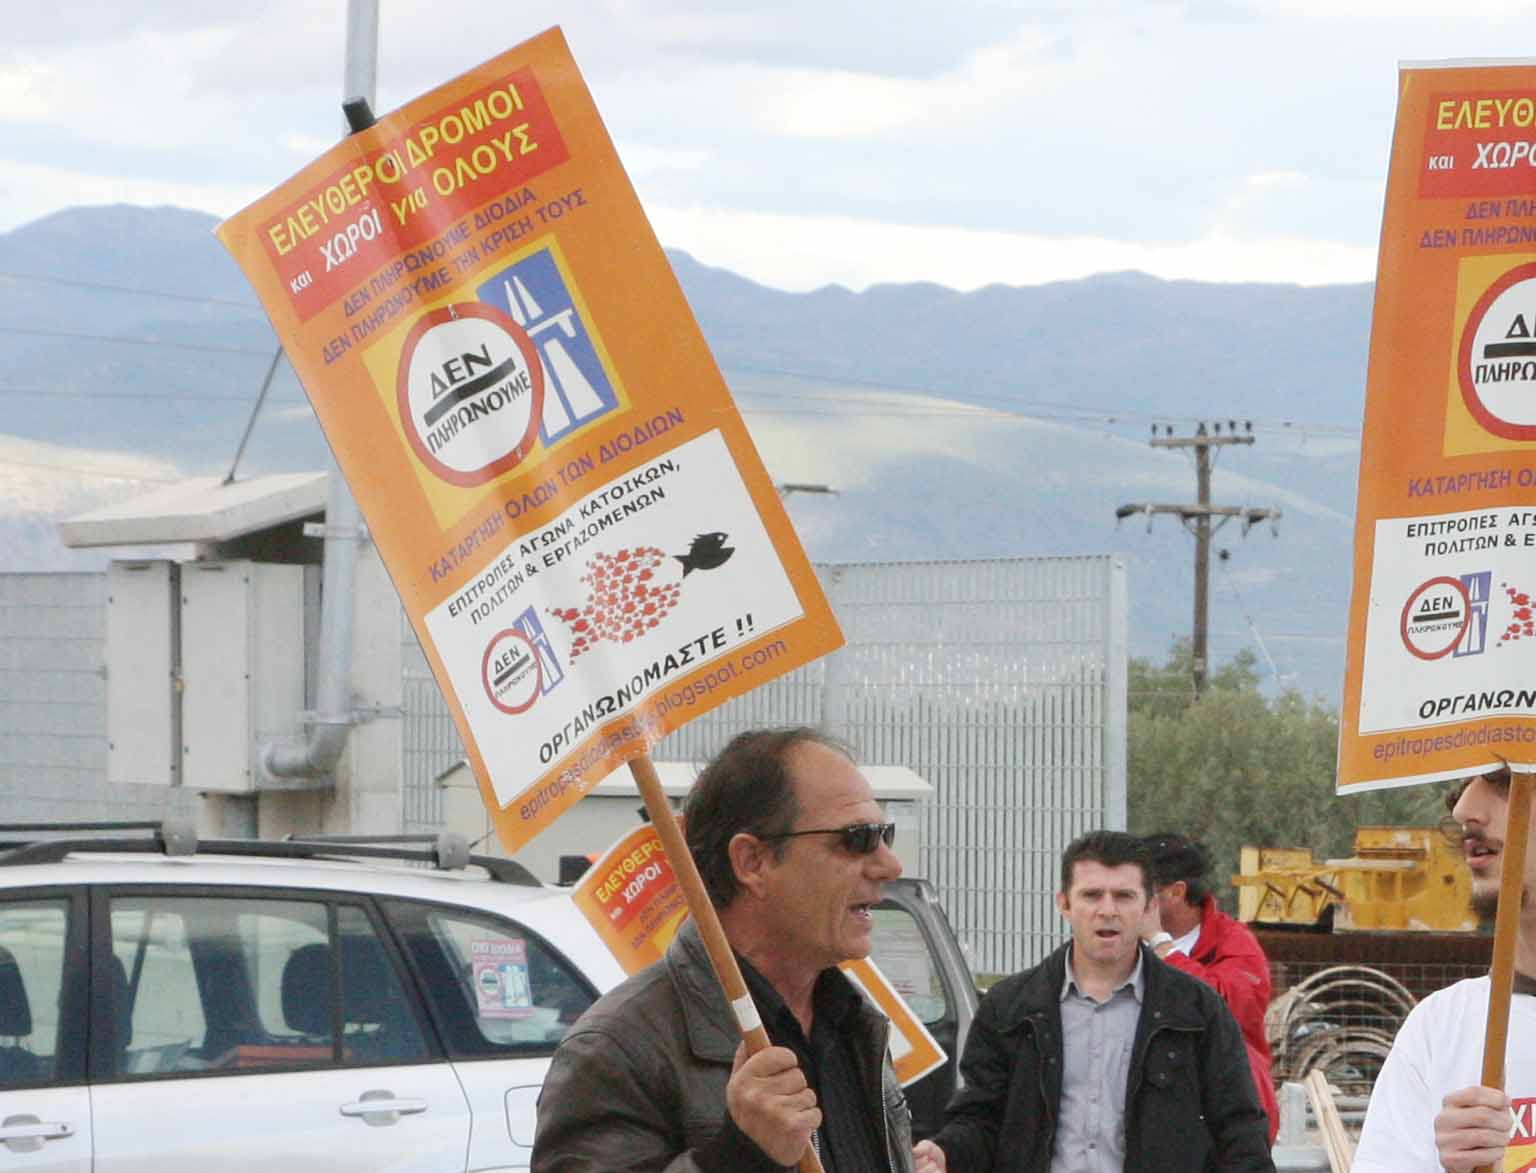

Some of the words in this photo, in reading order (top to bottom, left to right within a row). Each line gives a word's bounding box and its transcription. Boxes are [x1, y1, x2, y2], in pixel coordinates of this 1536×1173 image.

[268, 149, 408, 257] ΕΛΕΥΘΕΡΟΙ
[404, 83, 524, 169] ΔΡΟΜΟΙ
[1427, 154, 1455, 171] και
[289, 270, 313, 295] και
[319, 207, 383, 273] ΧΩΡΟΙ
[391, 187, 428, 226] για
[431, 123, 538, 197] ΟΛΟΥΣ
[473, 186, 537, 231] ΔΙΟΔΙΑ
[480, 214, 534, 258] ΚΡΙΣΗ
[535, 187, 589, 224] ΤΟΥΣ
[1465, 201, 1500, 221] ΔΕΝ
[1419, 229, 1457, 249] ΔΕΝ
[430, 343, 494, 401] ΔΕΝ
[426, 370, 532, 454] ΠΛΗΡΩΝΟΥΜΕ
[504, 480, 559, 520] ΟΛΩΝ
[599, 406, 686, 465] ΔΙΟΔΙΩΝ
[1407, 467, 1512, 499] ΚΑΤΑΡΓΗΣΗ
[447, 553, 516, 619] ΕΠΙΤΡΟΠΕΣ
[518, 518, 576, 558] ΑΓΩΝΑ
[578, 457, 682, 521] ΚΑΤΟΙΚΩΝ,
[1406, 513, 1499, 539] ΕΠΙΤΡΟΠΕΣ
[1424, 534, 1498, 558] ΠΟΛΙΤΩΝ
[1504, 532, 1517, 547] &
[469, 571, 526, 625] ΠΟΛΙΤΩΝ
[525, 561, 540, 578] &
[541, 486, 666, 569] ΕΡΓΑΖΟΜΕΝΩΝ
[1420, 595, 1454, 613] ΔΕΝ
[495, 643, 520, 675] ΔΕΝ
[538, 625, 728, 765] ΟΡΓΑΝΩΝΟΜΑΣΤΕ
[734, 612, 756, 638] !!
